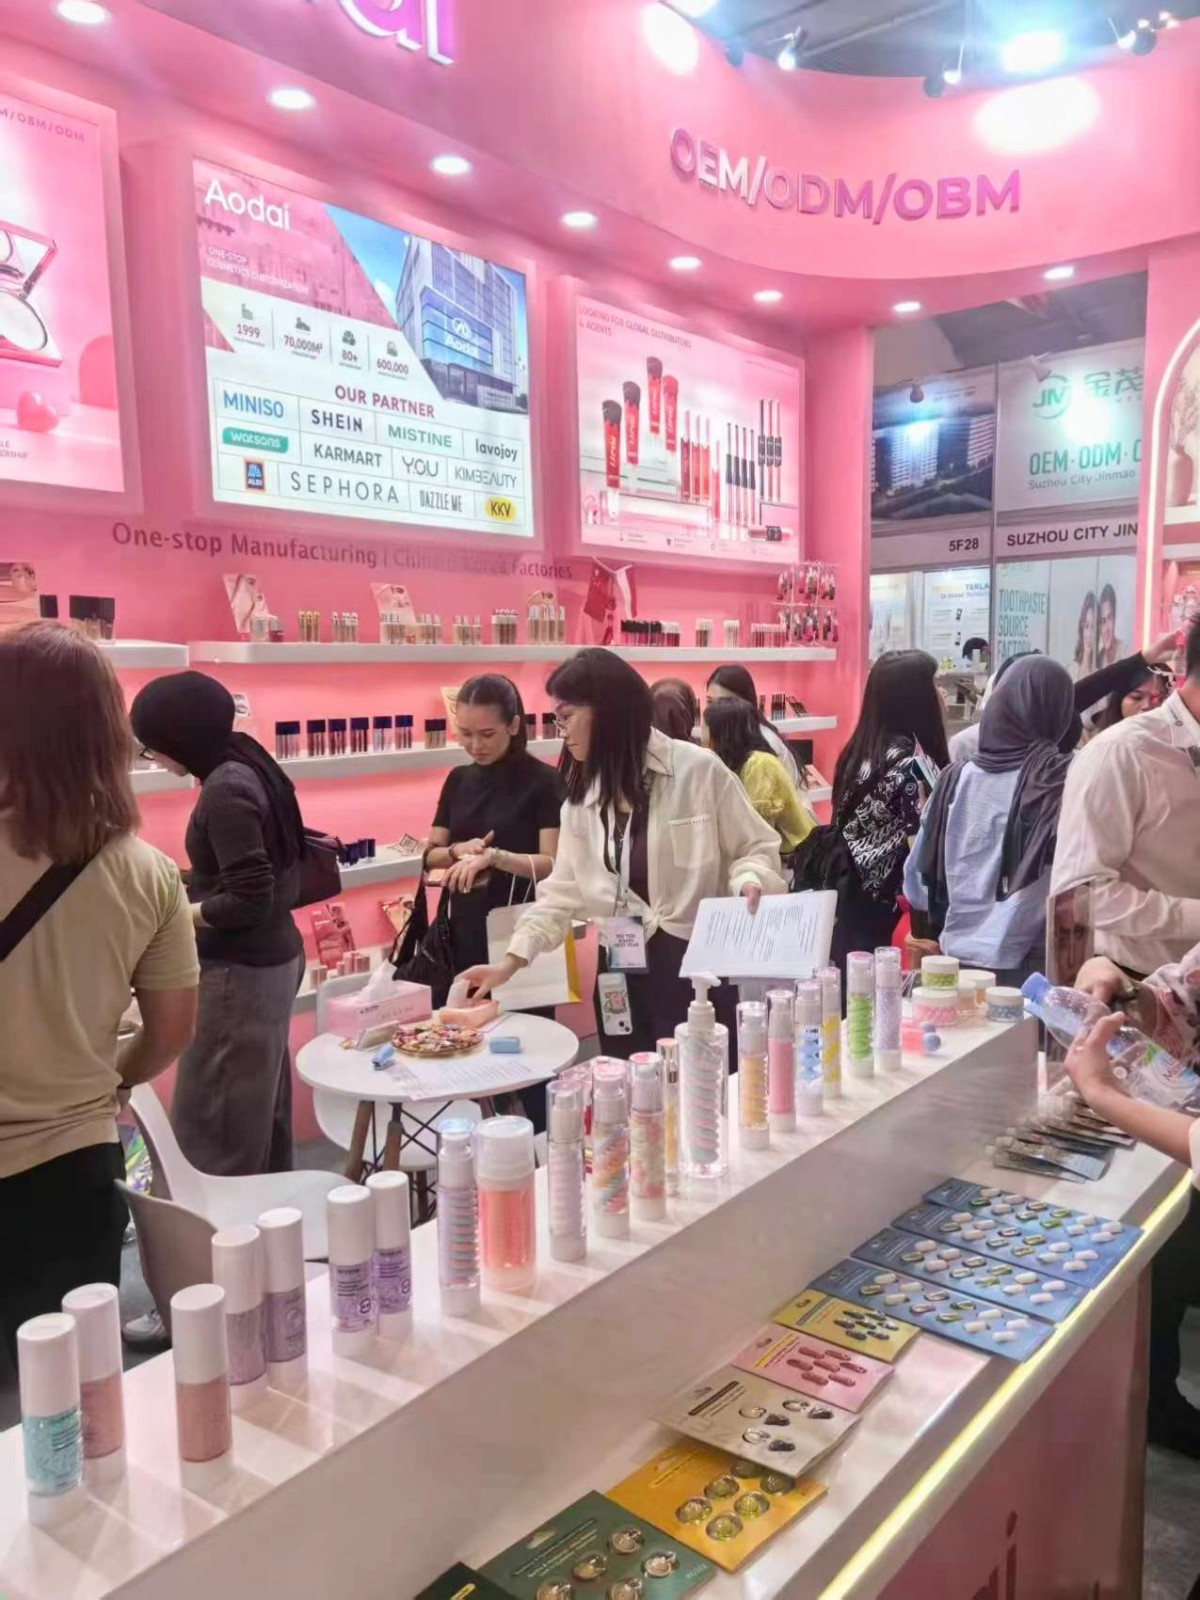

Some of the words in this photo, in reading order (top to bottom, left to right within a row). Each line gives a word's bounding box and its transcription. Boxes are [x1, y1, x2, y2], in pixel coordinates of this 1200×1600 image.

[670, 127, 1020, 225] OEM/ODM/OBM
[204, 178, 290, 231] Aodai
[237, 323, 261, 339] 1999
[341, 349, 358, 362] 80+
[376, 357, 409, 375] 600,000
[223, 390, 284, 419] MINISO
[335, 384, 367, 405] OUR
[372, 391, 435, 419] PARTNER
[311, 408, 363, 433] SHEIN
[230, 431, 282, 449] watsons
[388, 424, 453, 448] MISTINE
[314, 443, 382, 468] KARMART
[475, 438, 518, 462] lavojoy
[1029, 448, 1069, 476] OEM
[1079, 440, 1121, 470] ODM
[290, 470, 400, 504] SEPHORA
[1028, 478, 1067, 490] Suzhou
[1071, 473, 1092, 486] City
[1095, 468, 1136, 482] Jinmao
[419, 489, 449, 512] DAZZLE
[490, 500, 512, 519] KKV
[948, 537, 979, 552] 5F28
[1007, 529, 1069, 547] SUZHOU
[1073, 525, 1109, 542] CITY
[112, 522, 223, 557] One-stop
[231, 533, 378, 570] Manufacturing
[512, 553, 573, 579] Factories
[998, 588, 1047, 615] TOOTHPASTE
[997, 614, 1029, 638] SOURCE
